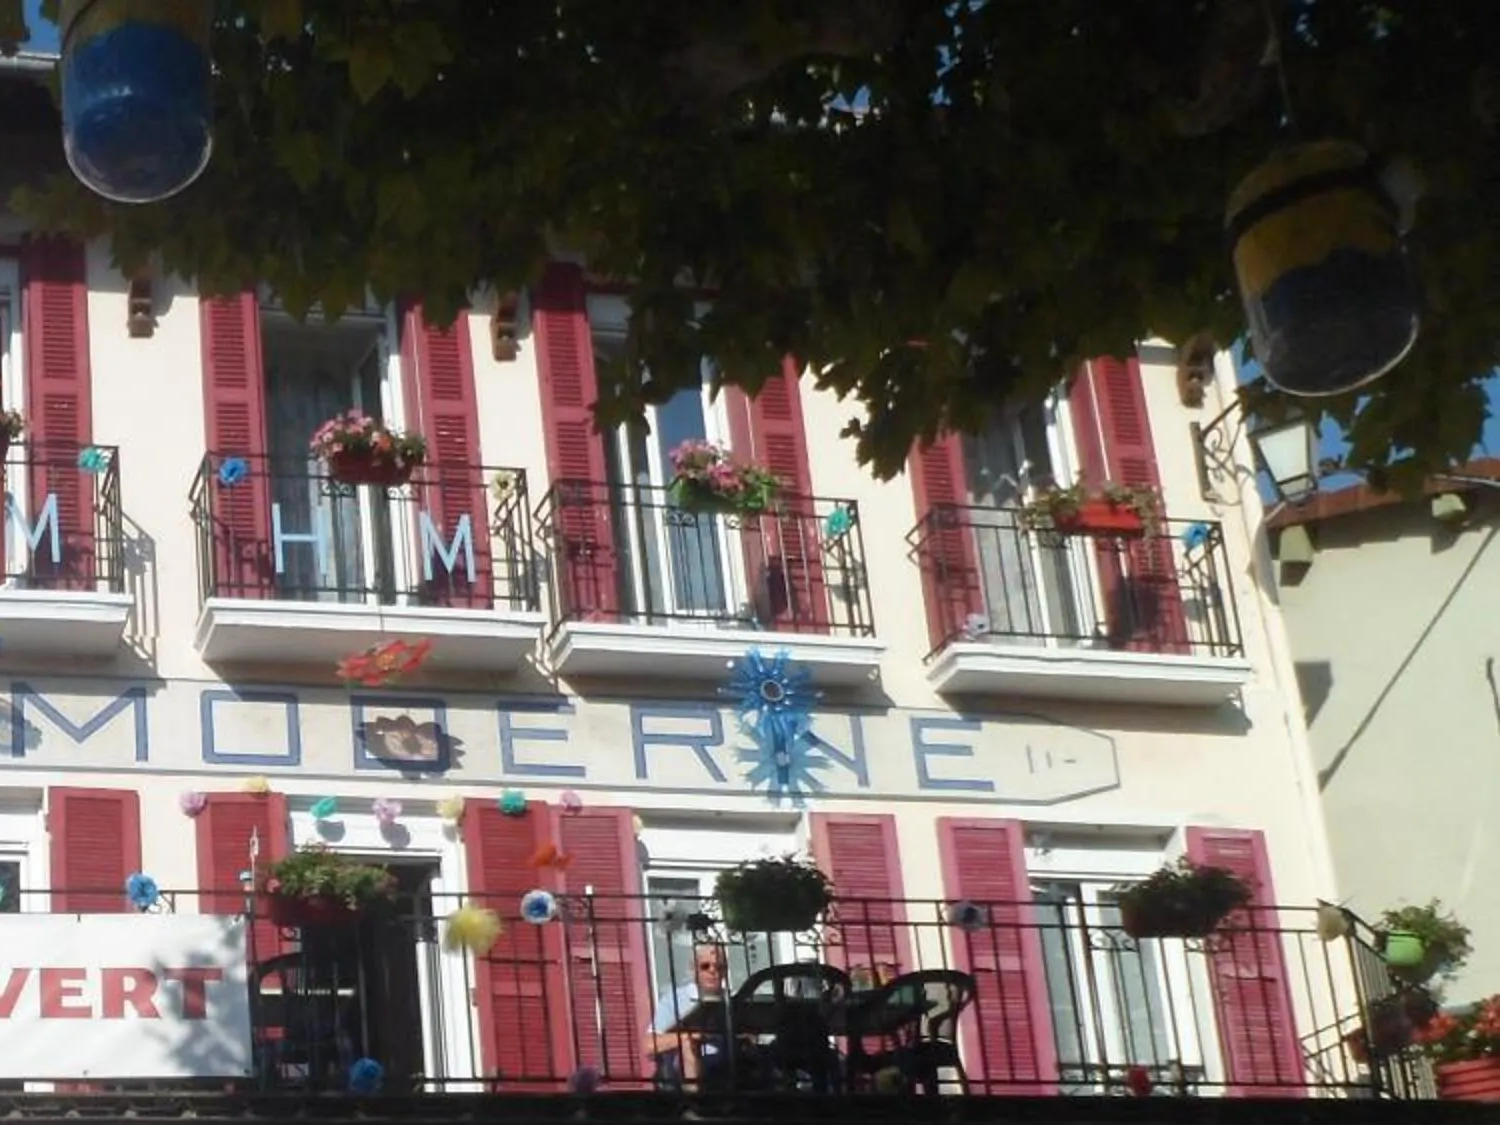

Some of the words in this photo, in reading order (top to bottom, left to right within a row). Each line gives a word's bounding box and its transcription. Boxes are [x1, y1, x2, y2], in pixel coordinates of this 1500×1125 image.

[4, 490, 62, 563] M
[271, 502, 329, 574] H
[418, 508, 476, 584] M
